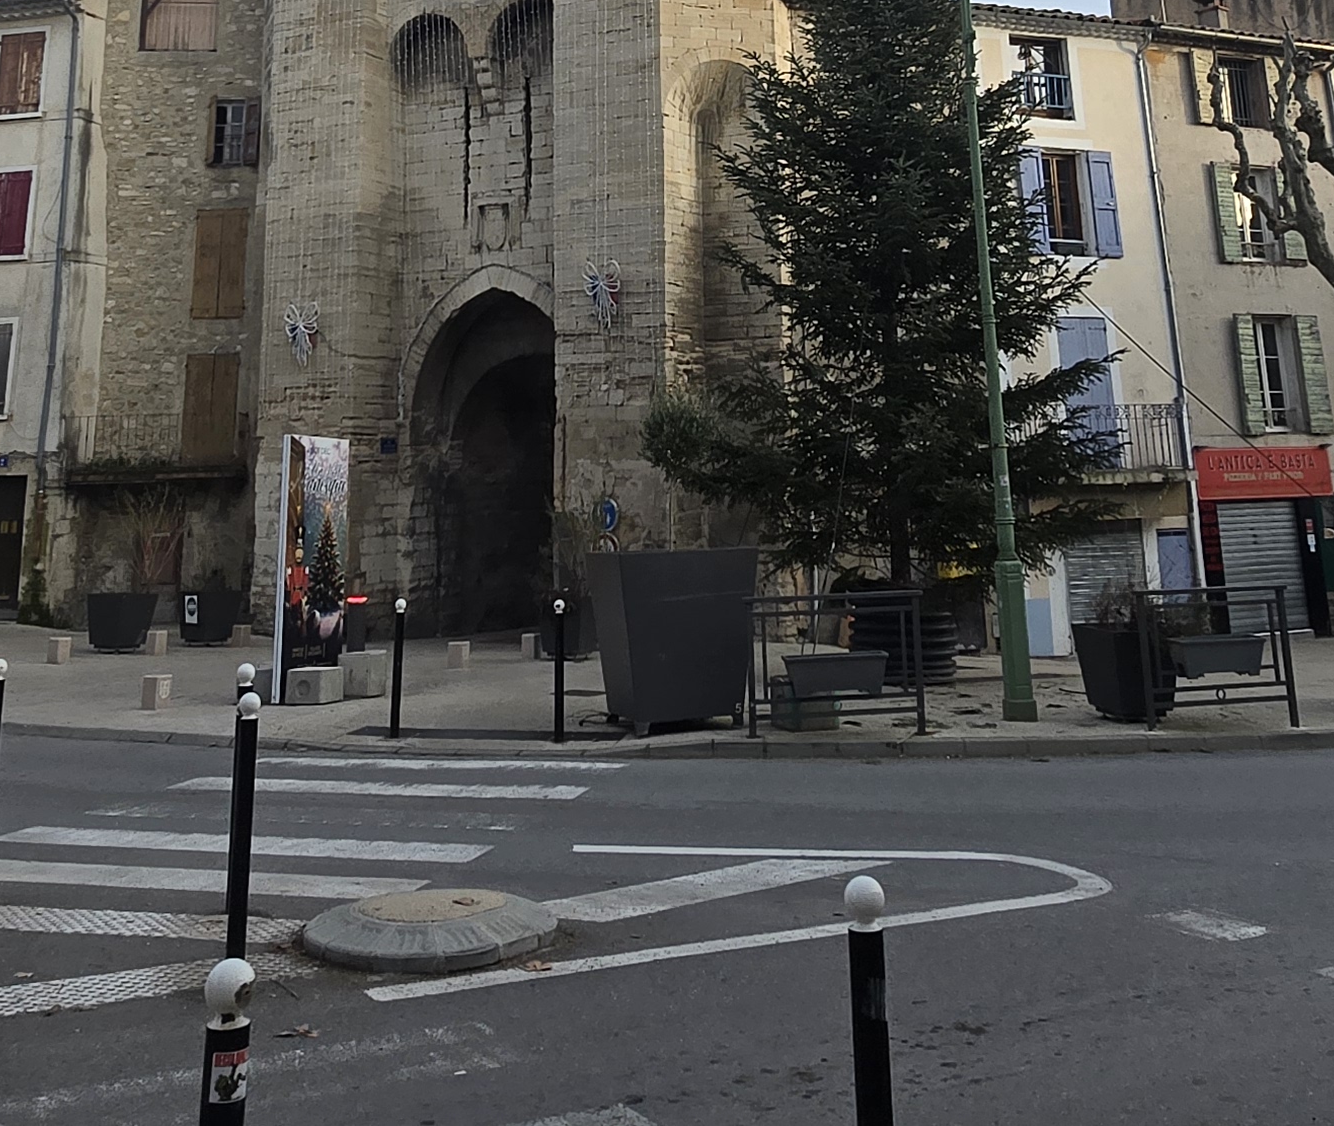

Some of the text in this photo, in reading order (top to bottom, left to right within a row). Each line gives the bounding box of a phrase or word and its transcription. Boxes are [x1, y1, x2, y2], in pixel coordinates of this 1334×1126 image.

[1207, 454, 1264, 472] L'ANTICA
[1280, 452, 1317, 469] BASTA
[735, 702, 742, 714] 5
